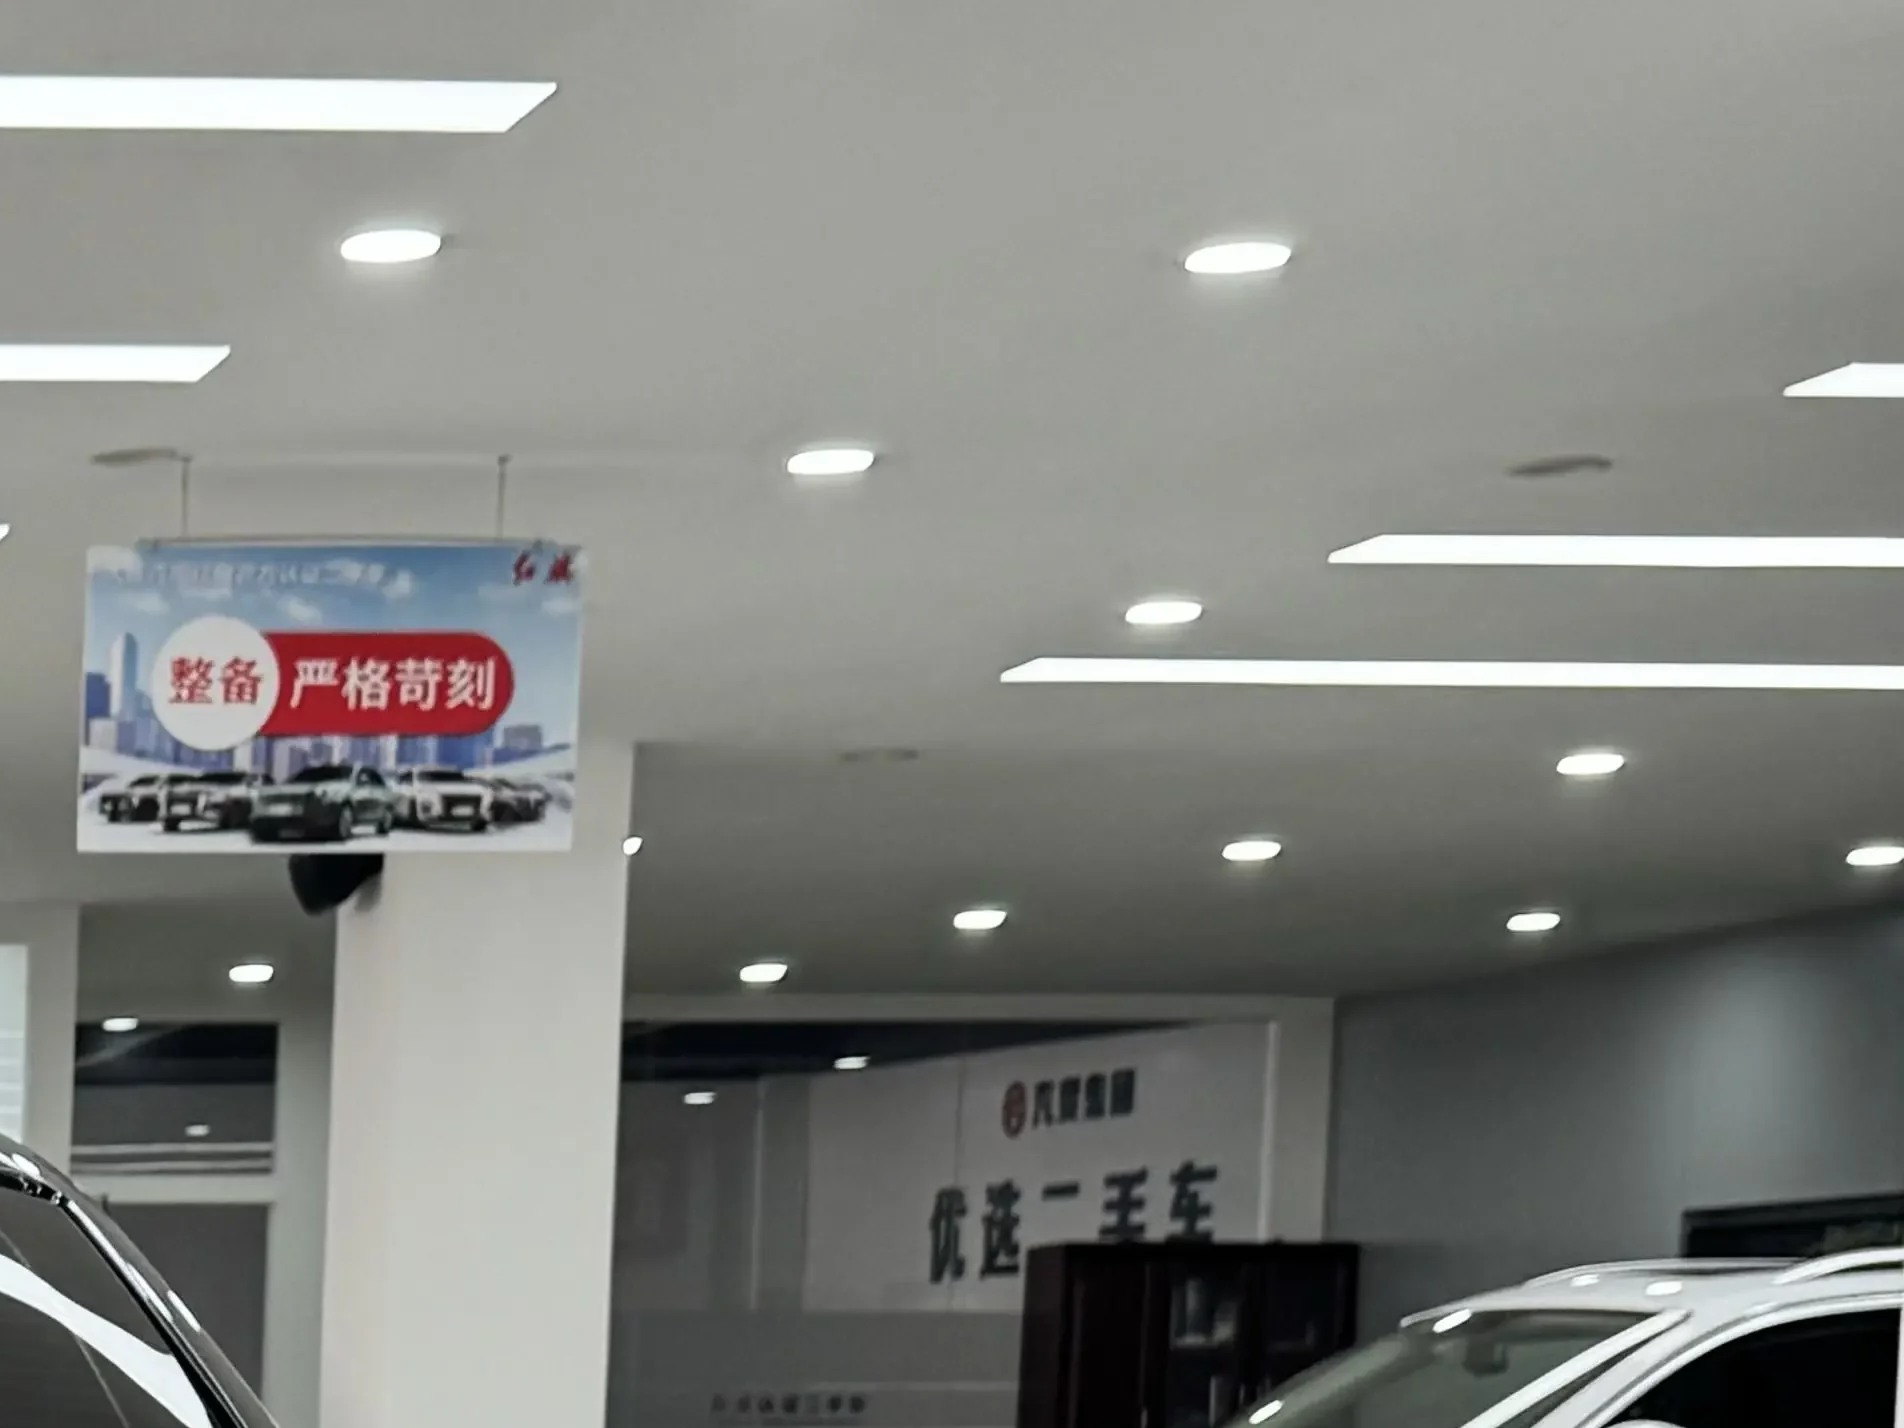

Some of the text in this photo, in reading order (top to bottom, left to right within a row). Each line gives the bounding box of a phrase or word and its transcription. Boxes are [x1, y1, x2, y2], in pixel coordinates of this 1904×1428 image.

[168, 655, 496, 711] 整备 严格苛刻
